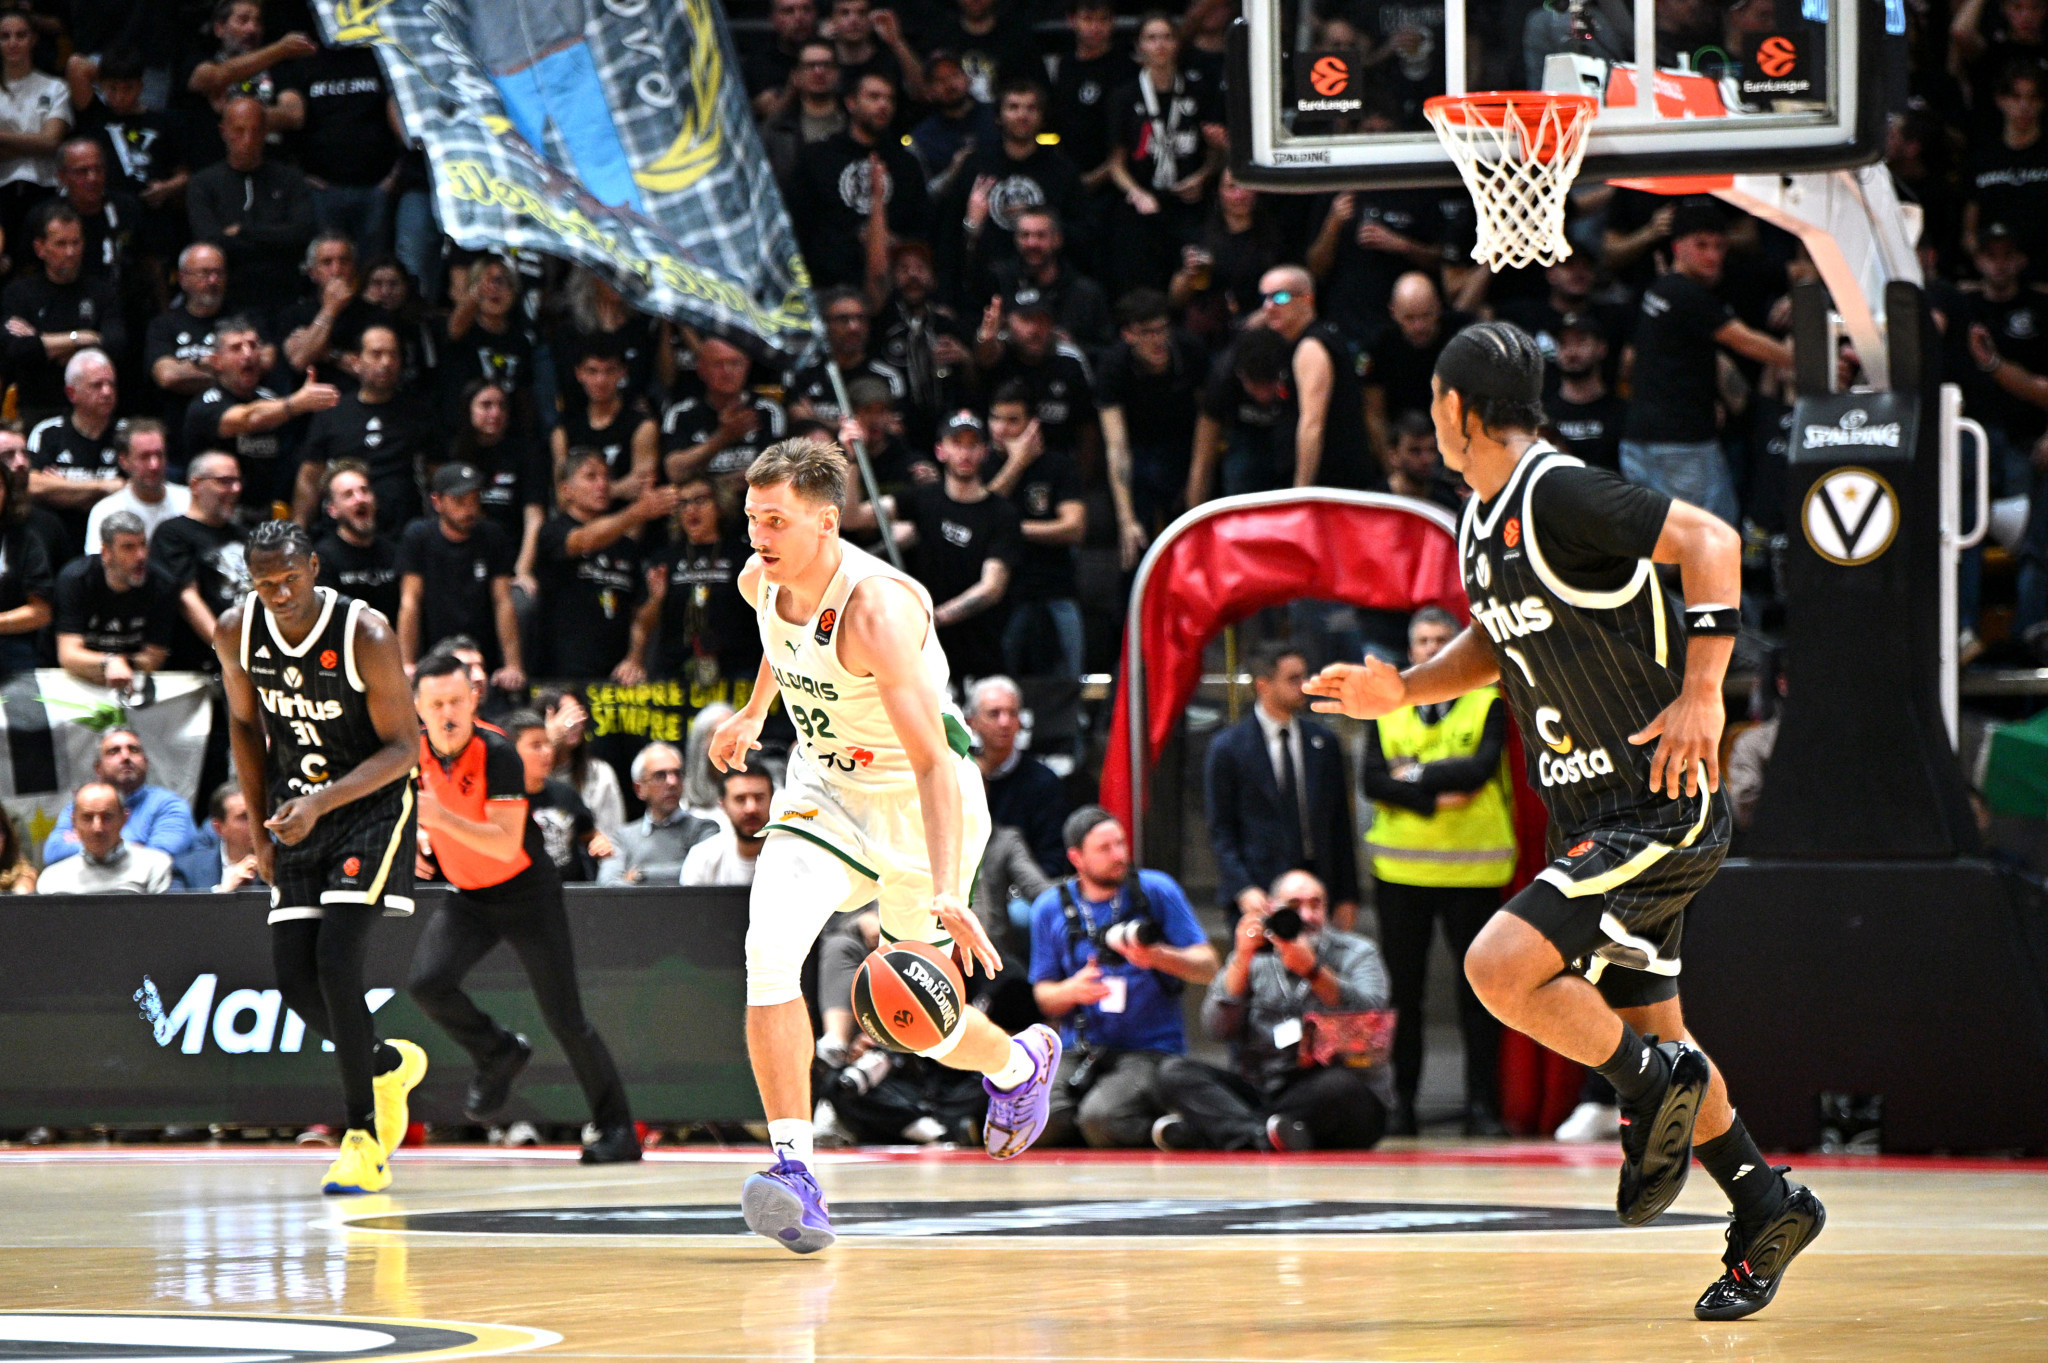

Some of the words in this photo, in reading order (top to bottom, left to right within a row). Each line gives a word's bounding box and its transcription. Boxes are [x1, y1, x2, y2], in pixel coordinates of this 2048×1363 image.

[1743, 79, 1810, 94] EuroLeague
[1298, 99, 1362, 112] EuroLeague
[1803, 422, 1901, 449] SPALDING
[257, 686, 344, 721] Virtus
[290, 720, 323, 747] 31
[792, 704, 838, 739] 92
[1538, 747, 1615, 787] Costa
[902, 961, 957, 1033] SPALDING
